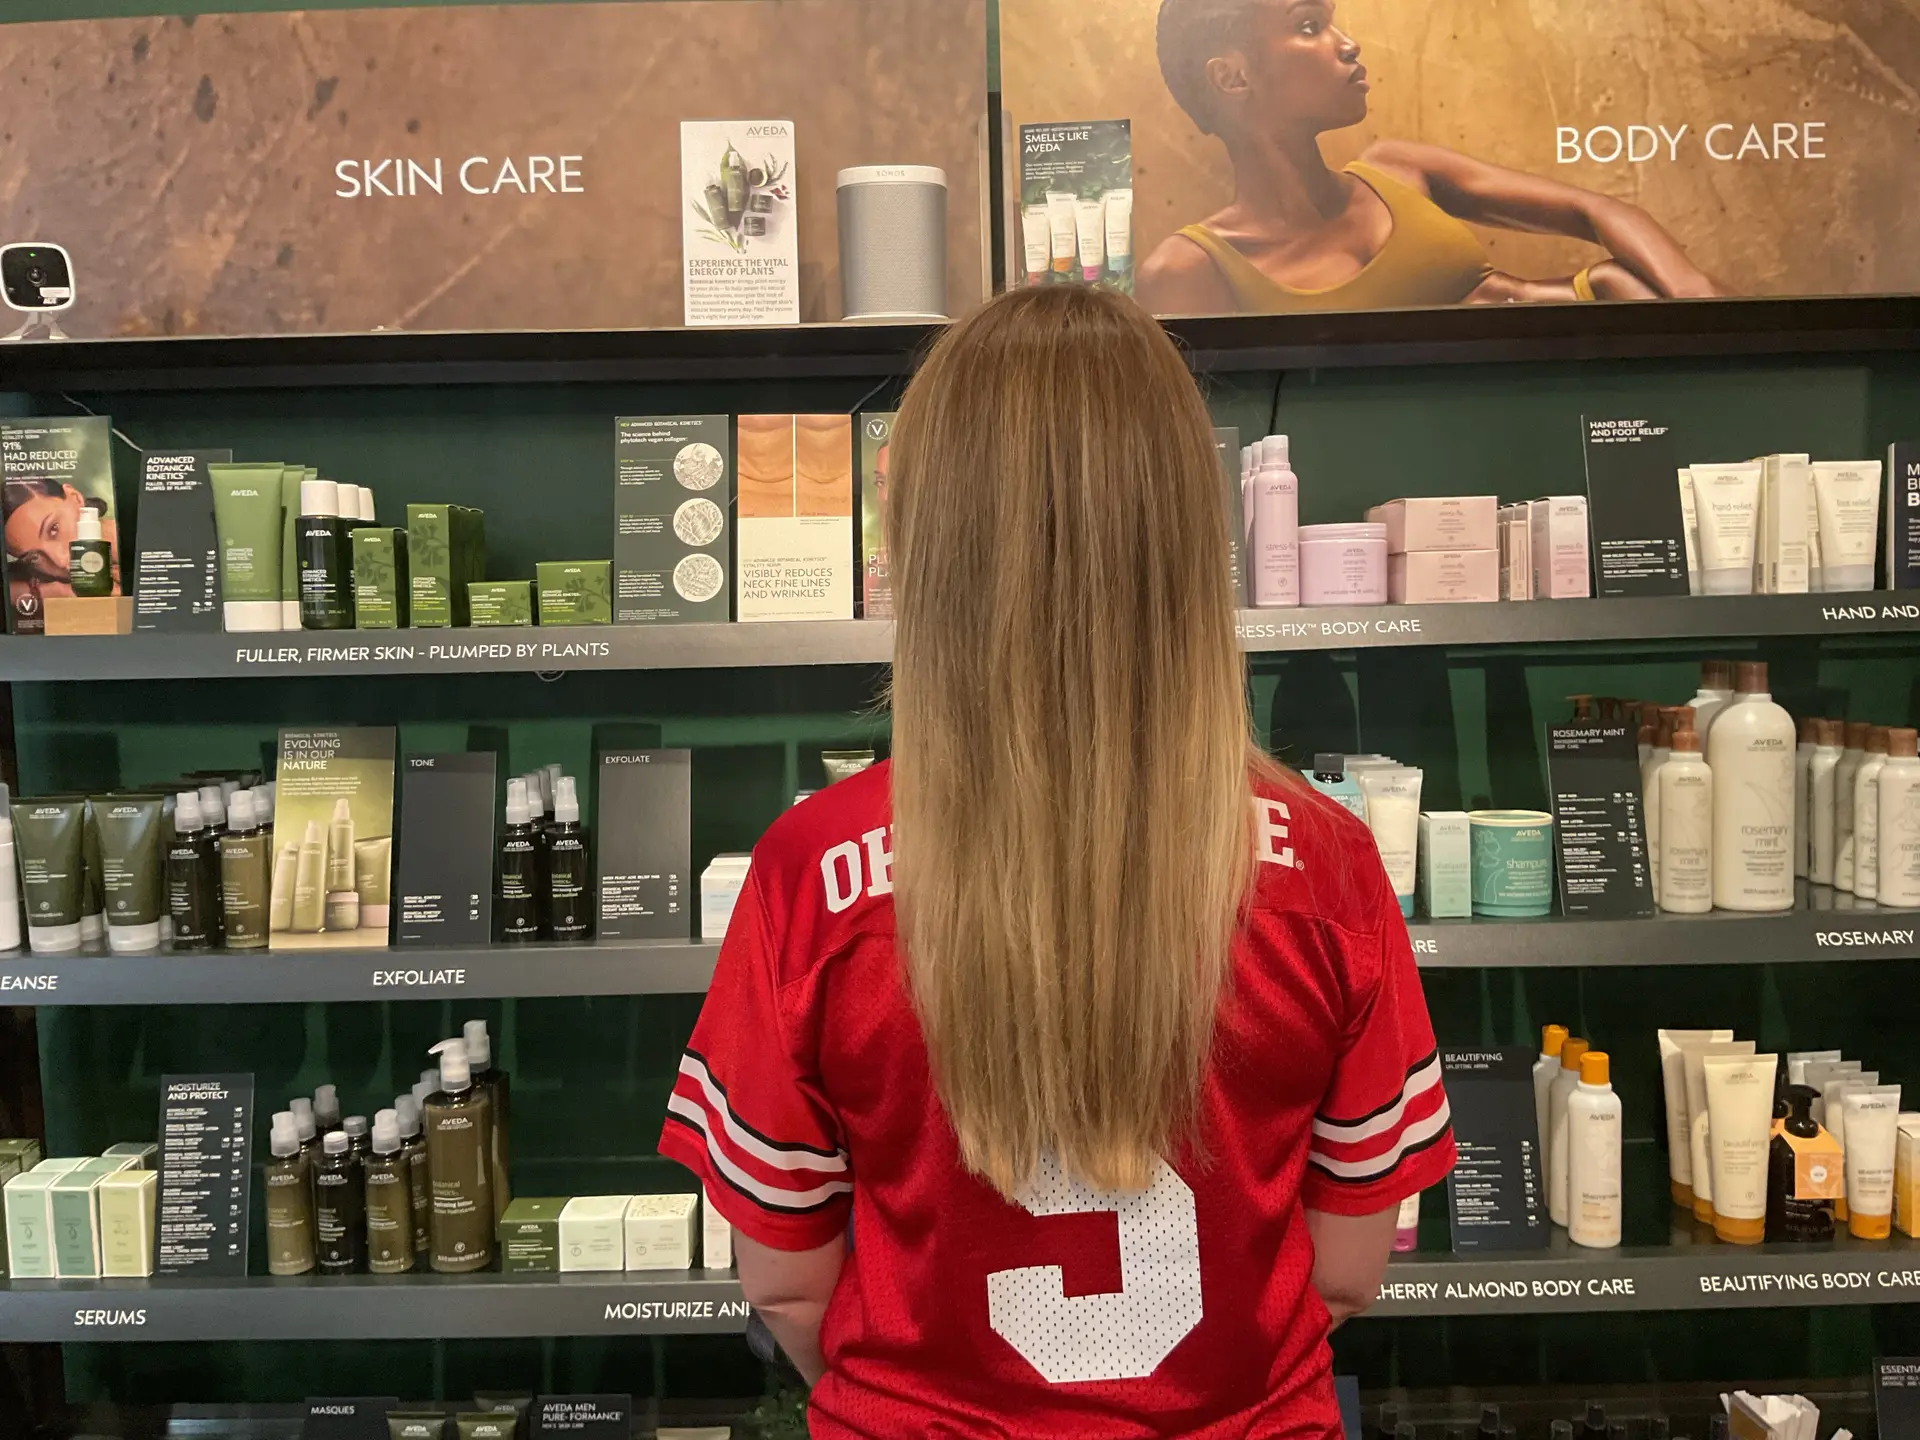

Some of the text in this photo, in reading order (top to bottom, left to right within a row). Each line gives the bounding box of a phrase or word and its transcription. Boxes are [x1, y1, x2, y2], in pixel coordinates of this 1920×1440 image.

[747, 126, 788, 136] AVEDA
[1025, 131, 1089, 143] SMELLS LIKE
[1556, 122, 1826, 163] BODY CARE
[1025, 143, 1061, 153] AVEDA
[335, 156, 584, 198] SKIN CARE
[689, 258, 789, 267] EXPERIENCE THE VITAL
[689, 267, 775, 276] ENERGY OF PLANTS
[1589, 421, 1617, 429] HAND
[1591, 429, 1611, 437] AND
[1612, 428, 1637, 437] FOOT
[3, 441, 22, 450] 91%
[3, 450, 78, 461] HAD REDUCED
[146, 456, 195, 465] ADVANCED
[4, 462, 45, 472] FROWN
[146, 464, 195, 472] BOTANICAL
[743, 568, 833, 578] VISIBLY REDUCES
[743, 578, 831, 589] NECK FINE LINES
[743, 589, 826, 599] AND WRINKLES
[1822, 604, 1919, 621] HAND AND
[1321, 620, 1370, 636] BODY
[1375, 619, 1422, 634] CARE
[236, 642, 610, 664] FULLER, FIRMER SKIN PLUMPED BY PLANTS
[1553, 728, 1625, 738] ROSEMARY MINT
[284, 739, 341, 749] EVOLVING
[283, 750, 336, 760] IS IN OUR
[605, 755, 651, 764] EXFOLIATE
[283, 760, 328, 770] NATURE
[410, 758, 435, 767] TONE
[1741, 824, 1789, 836] rosemary
[1755, 836, 1779, 848] mint
[1669, 847, 1709, 857] rosemary
[1506, 858, 1548, 870] shampure
[1679, 857, 1700, 865] mint
[1815, 930, 1914, 947] ROSEMARY
[0, 975, 58, 990] EANSE
[372, 969, 466, 986] EXFOLIATE
[1445, 1052, 1503, 1062] BEAUTIFYING
[168, 1082, 221, 1092] MOISTURIZE
[167, 1090, 229, 1101] AND PROTECT
[441, 1117, 468, 1125] AVEDA
[1589, 1113, 1615, 1121] AVEDA
[1699, 1270, 1920, 1293] BEAUTIFYING BODY CARE
[1376, 1278, 1635, 1301] HERRY ALMOND BODY CARE
[604, 1301, 714, 1320] MOISTURIZE
[73, 1309, 147, 1326] SERUMS
[310, 1405, 355, 1415] MASQUES
[543, 1403, 596, 1412] AVEDA MEN
